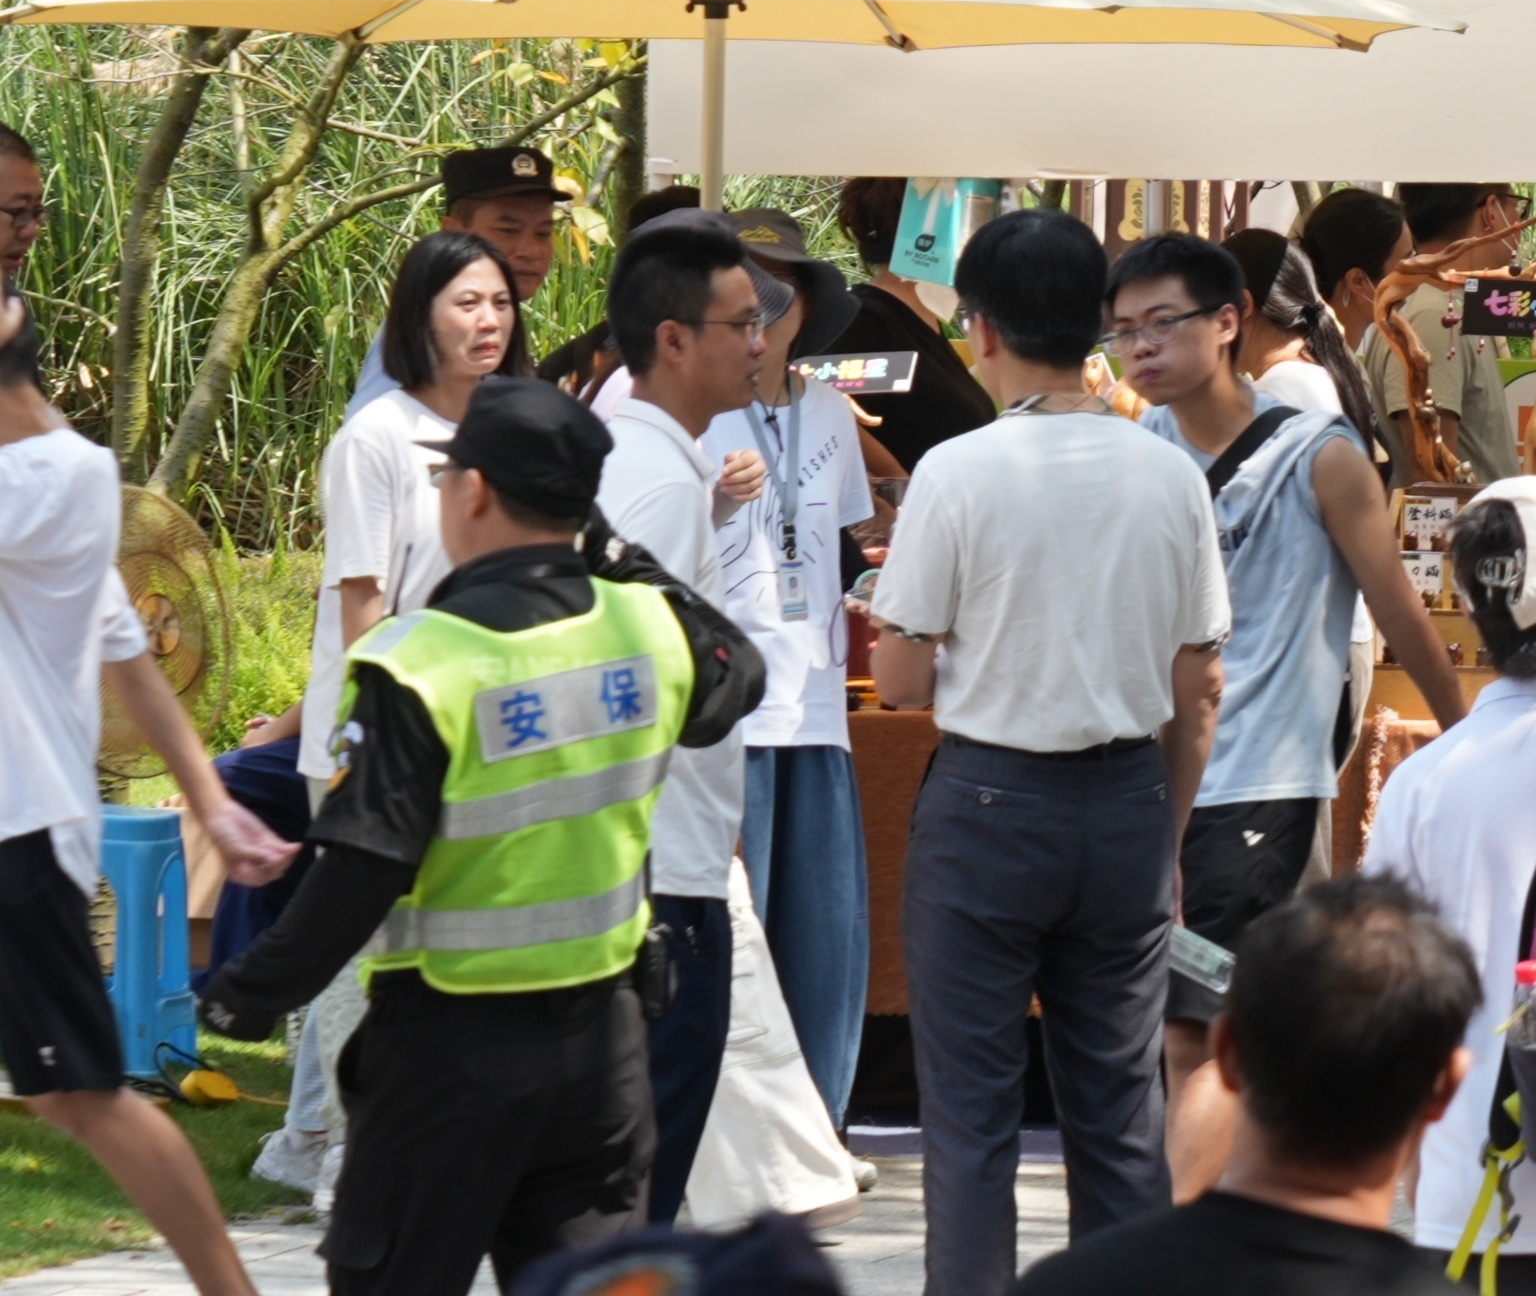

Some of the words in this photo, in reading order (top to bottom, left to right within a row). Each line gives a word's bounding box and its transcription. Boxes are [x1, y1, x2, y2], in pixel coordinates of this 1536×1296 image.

[789, 357, 889, 381] 小福星
[500, 666, 643, 749] 安保
